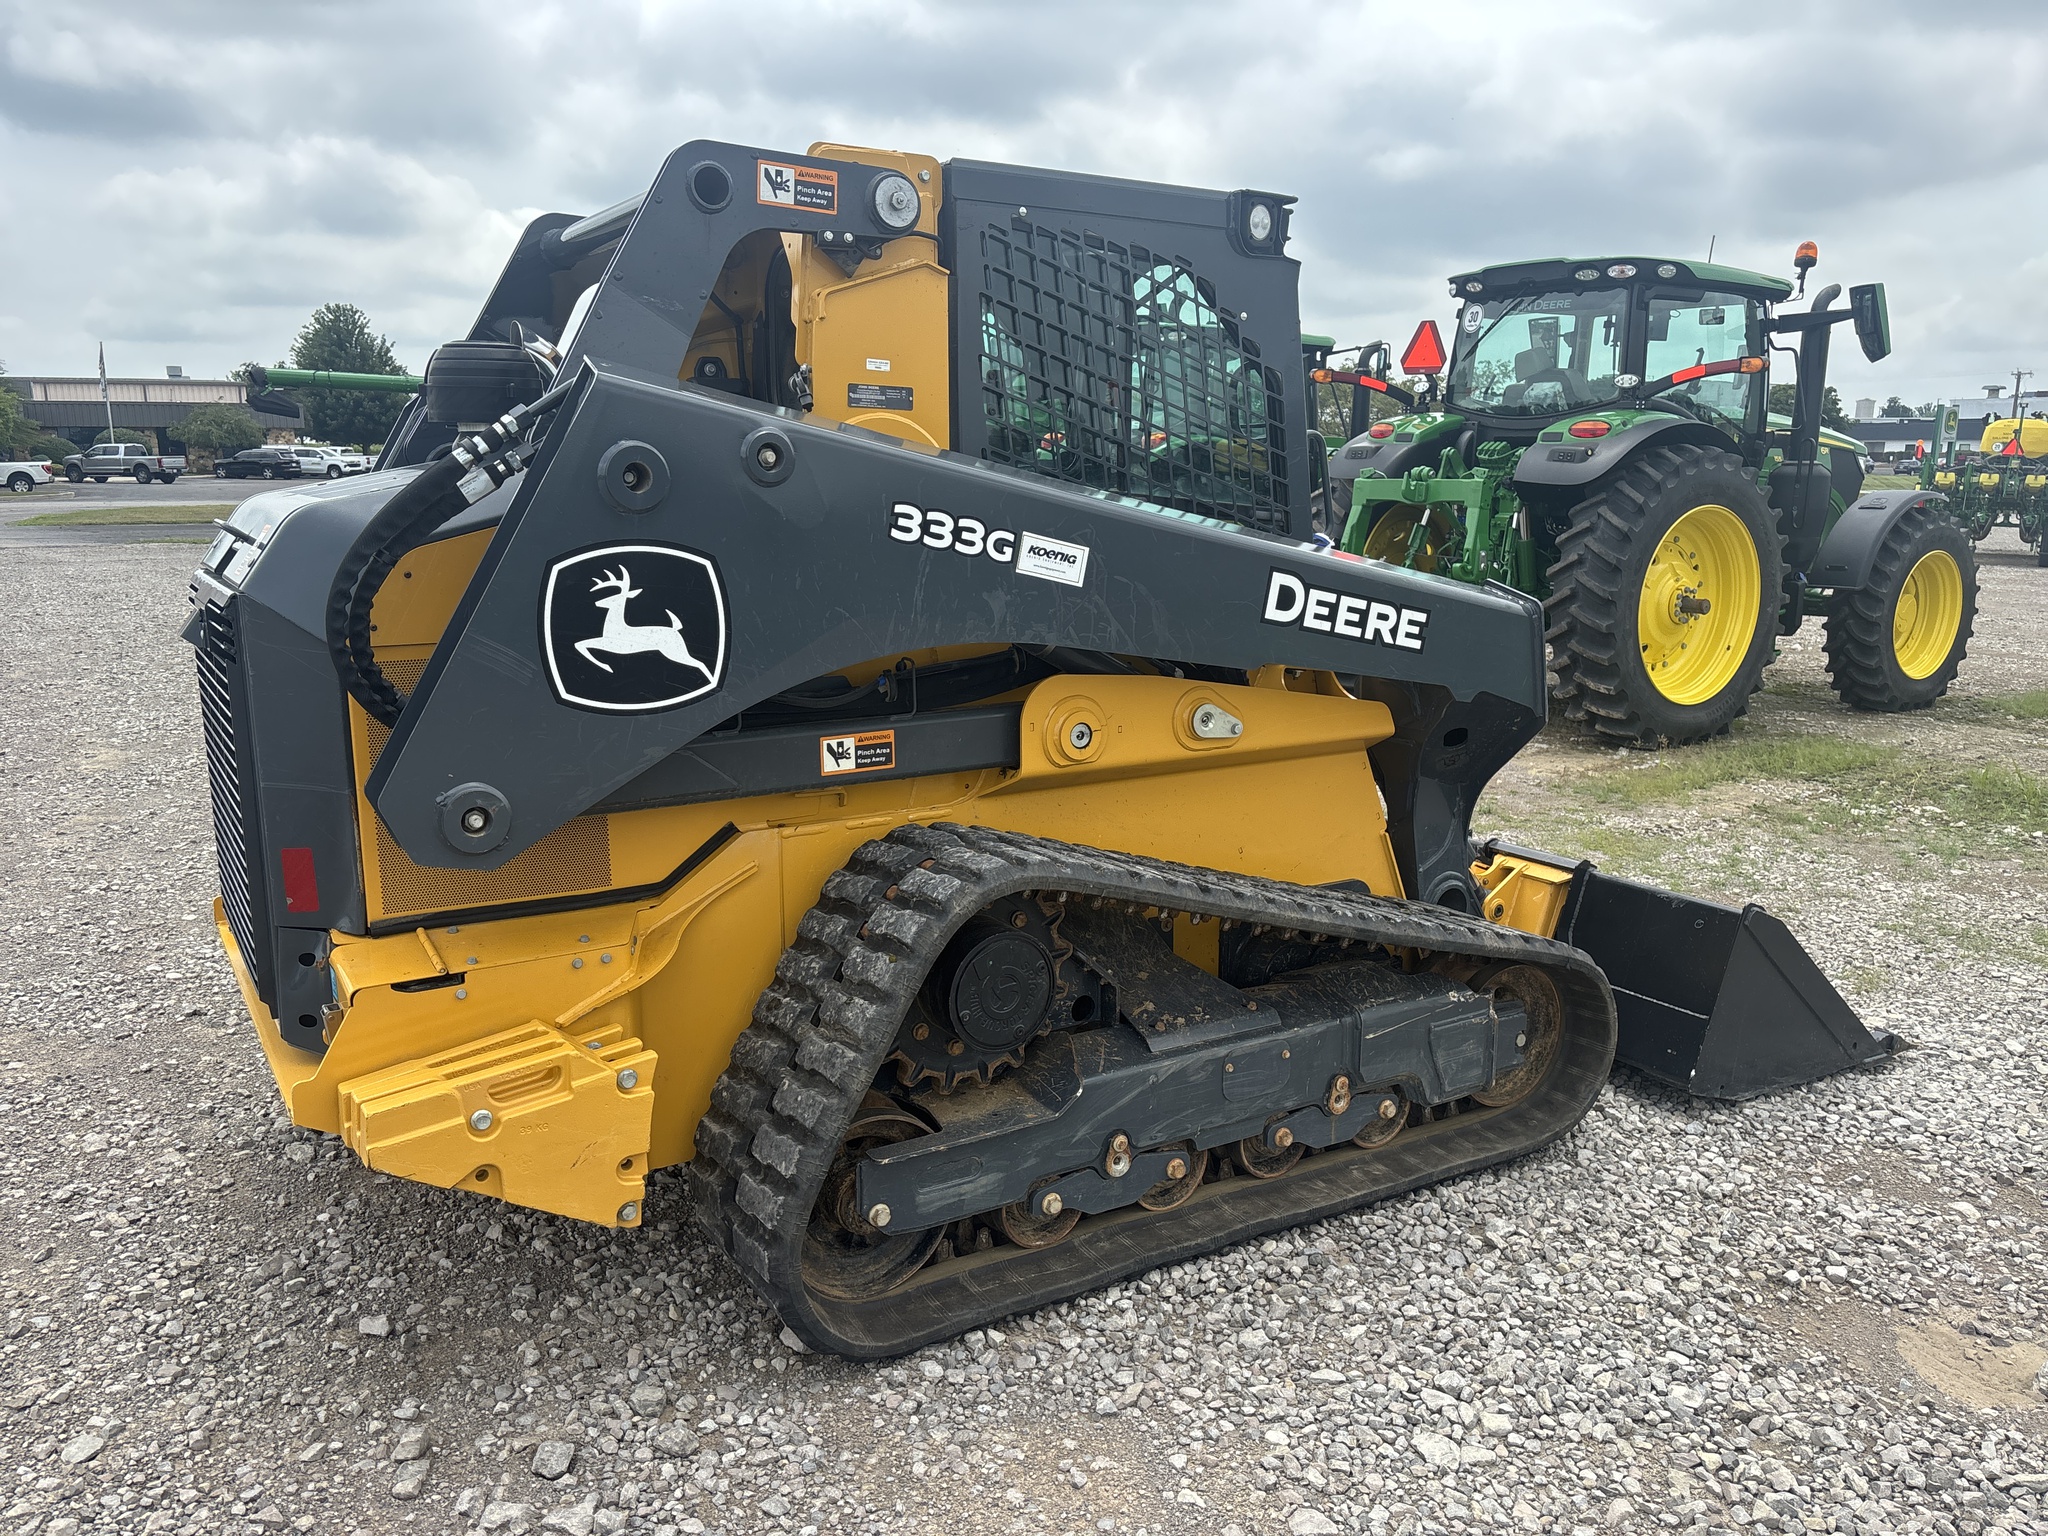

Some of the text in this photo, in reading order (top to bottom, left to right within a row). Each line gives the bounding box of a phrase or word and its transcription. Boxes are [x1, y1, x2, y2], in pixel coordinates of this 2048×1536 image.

[805, 172, 834, 181] WARNING
[797, 185, 833, 197] Pinch Area
[796, 195, 828, 206] Keep Away
[1534, 299, 1572, 311] DEERE
[1468, 310, 1480, 323] 30
[890, 503, 1016, 563] 333G
[1264, 571, 1428, 650] DEERE
[864, 734, 890, 742] WARNING
[857, 749, 875, 757] Pinch
[464, 1081, 483, 1093] USA
[535, 1122, 550, 1132] KG
